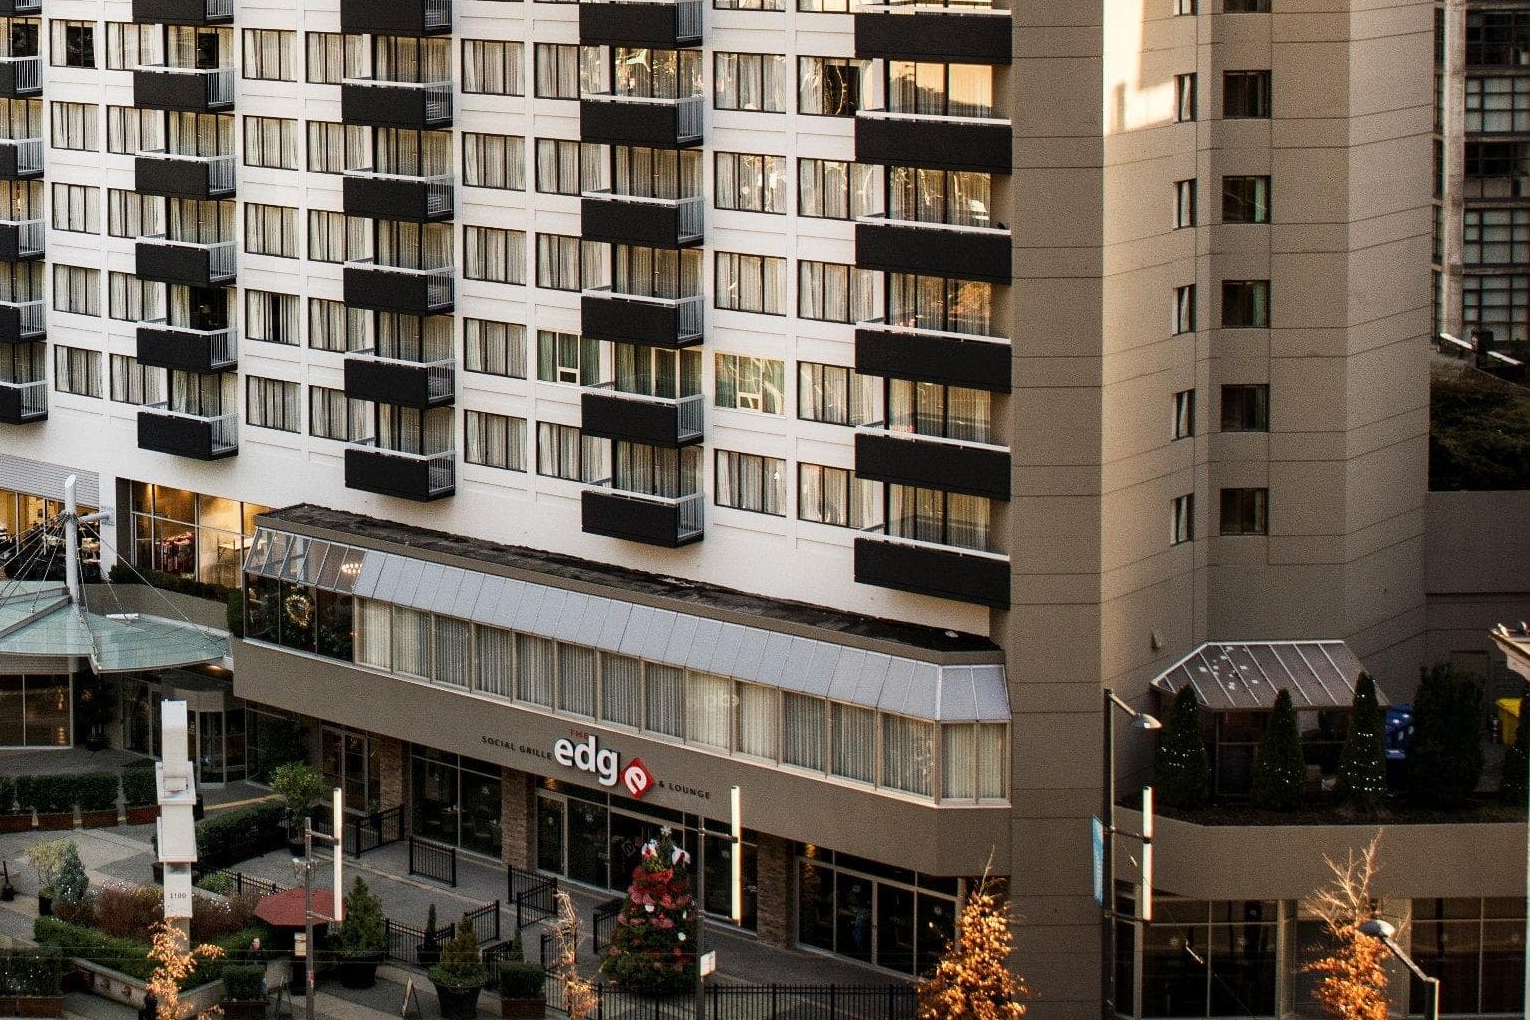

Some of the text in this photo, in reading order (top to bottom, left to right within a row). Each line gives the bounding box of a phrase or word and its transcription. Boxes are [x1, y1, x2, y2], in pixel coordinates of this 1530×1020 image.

[569, 729, 589, 740] THE
[481, 735, 553, 760] SOCIAL GRILLE
[658, 780, 711, 800] & LOUNGE
